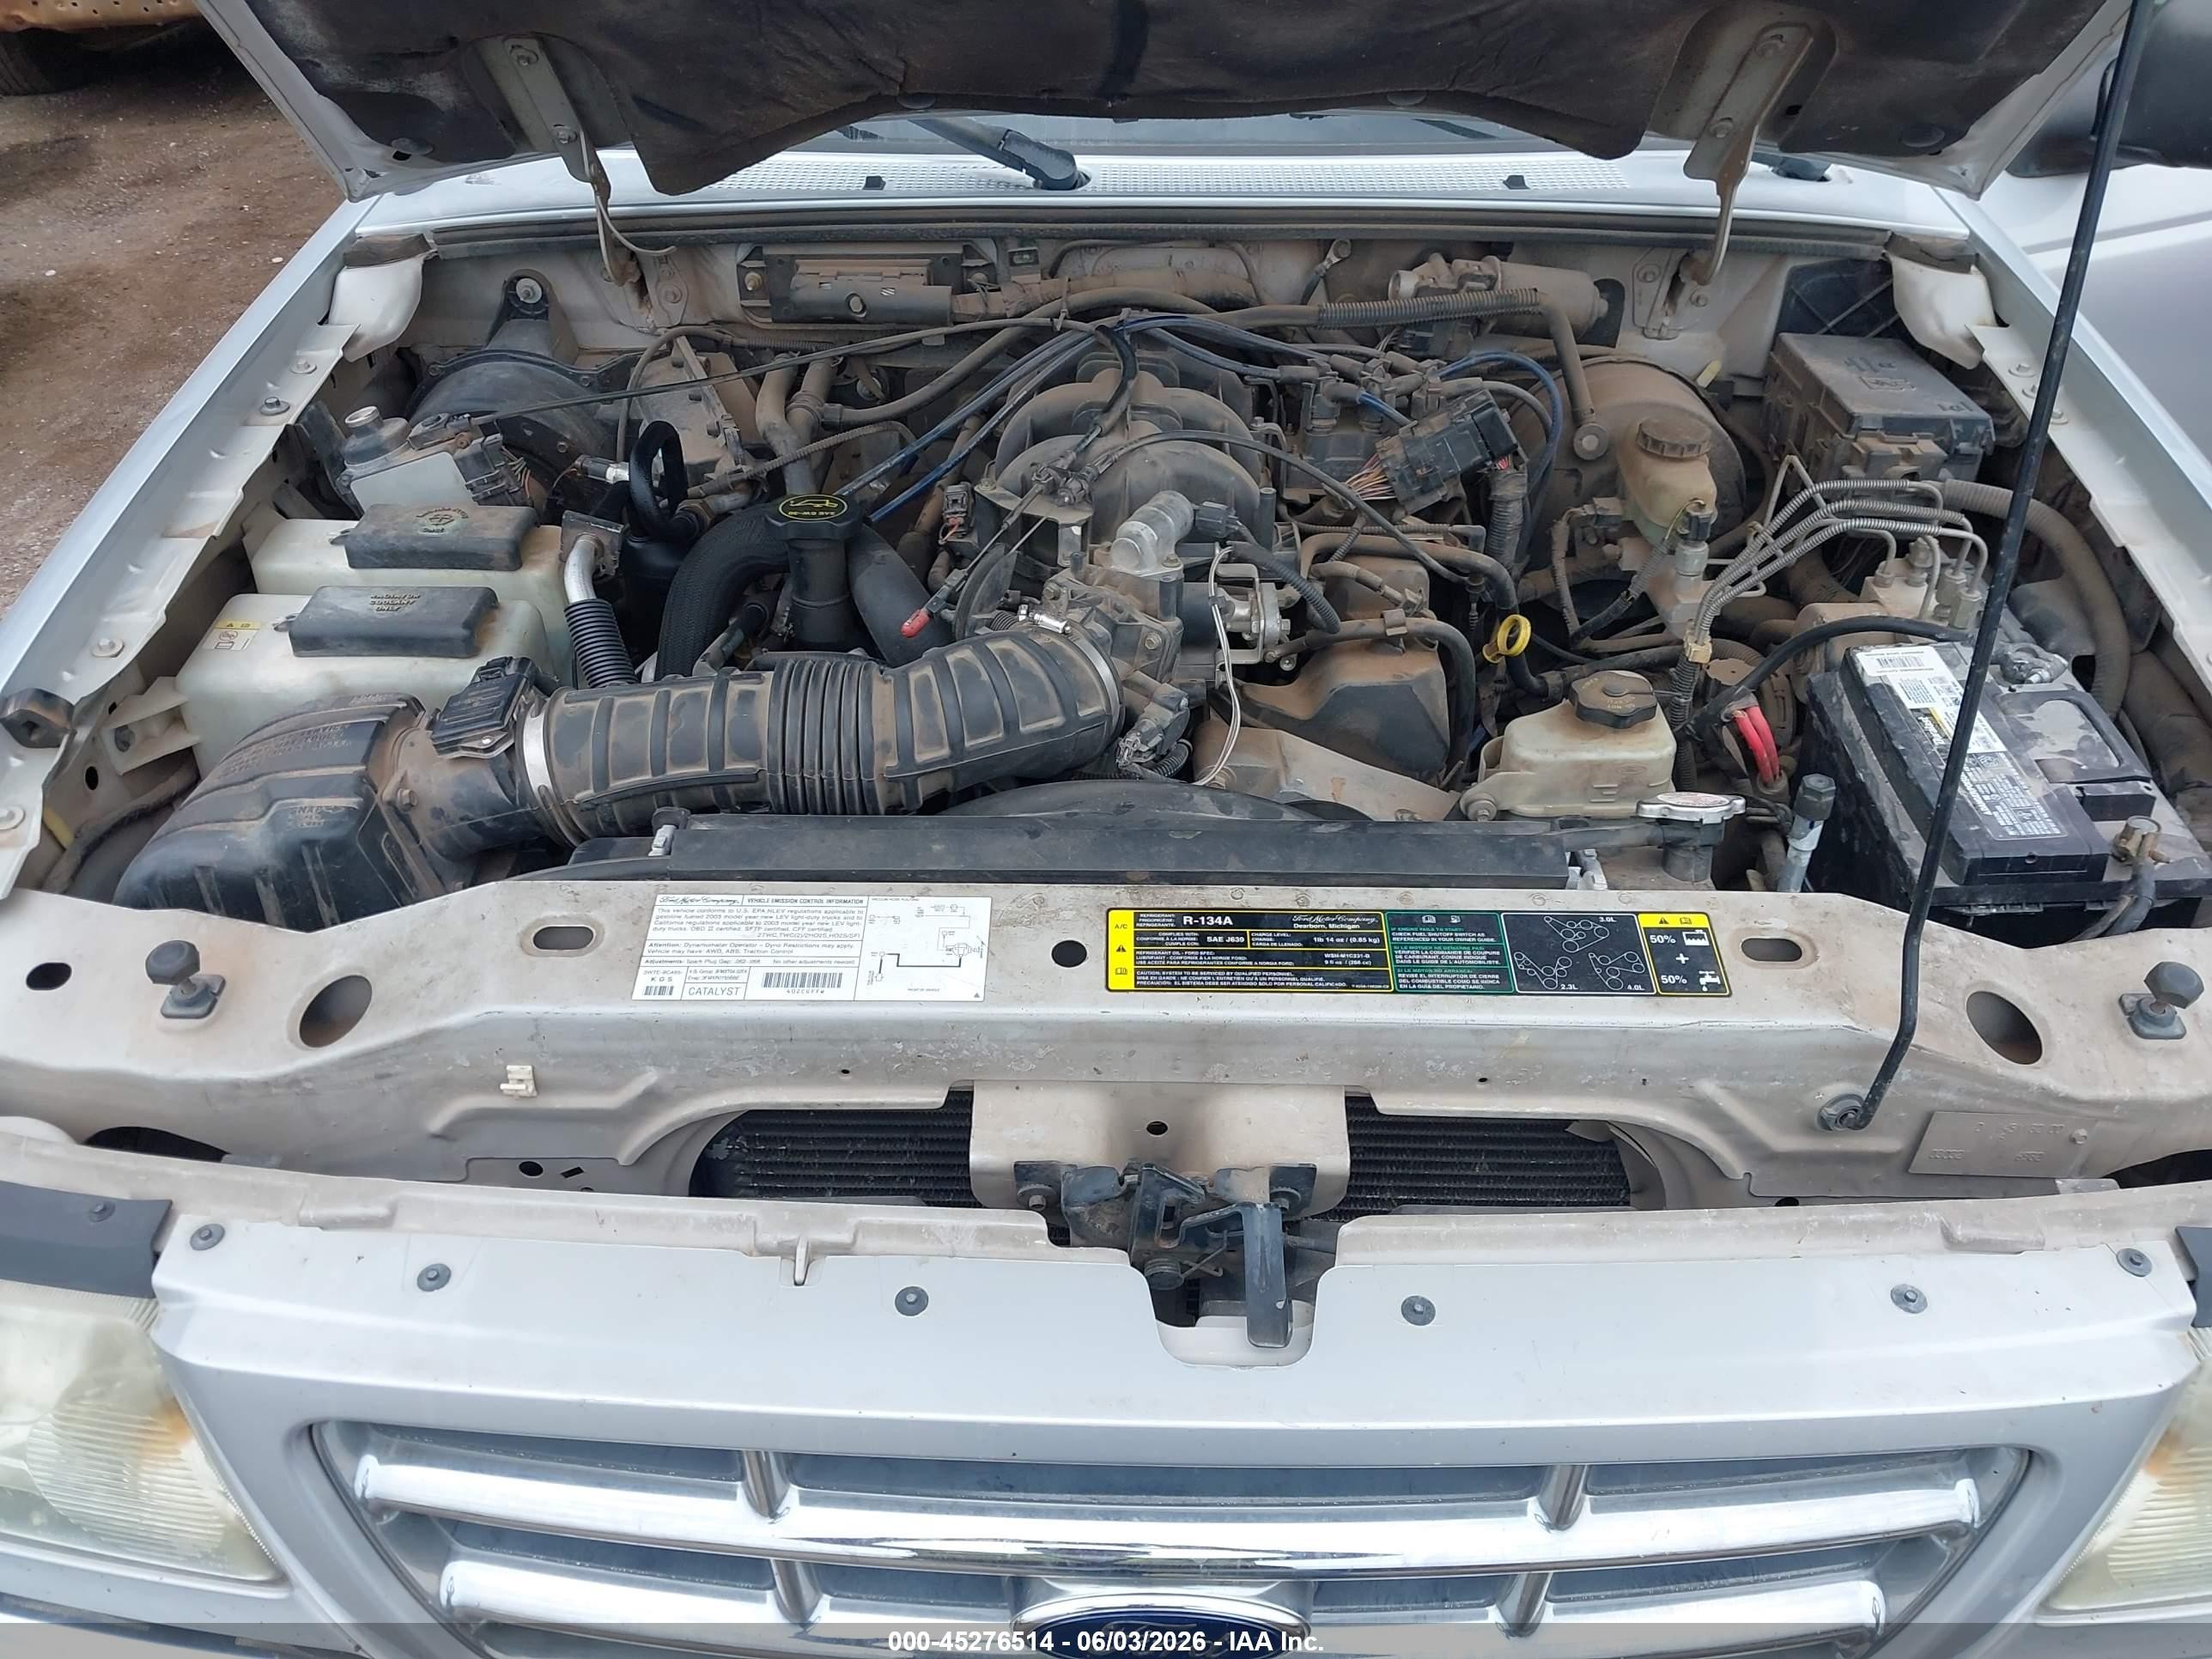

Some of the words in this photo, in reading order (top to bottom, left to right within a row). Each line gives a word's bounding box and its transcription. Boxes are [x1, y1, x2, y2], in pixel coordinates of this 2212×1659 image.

[1183, 916, 1233, 926] R-134A
[1312, 915, 1336, 924] Motor
[1650, 935, 1676, 944] 50%
[1661, 975, 1687, 984] 50%
[689, 987, 740, 996] CATALYST
